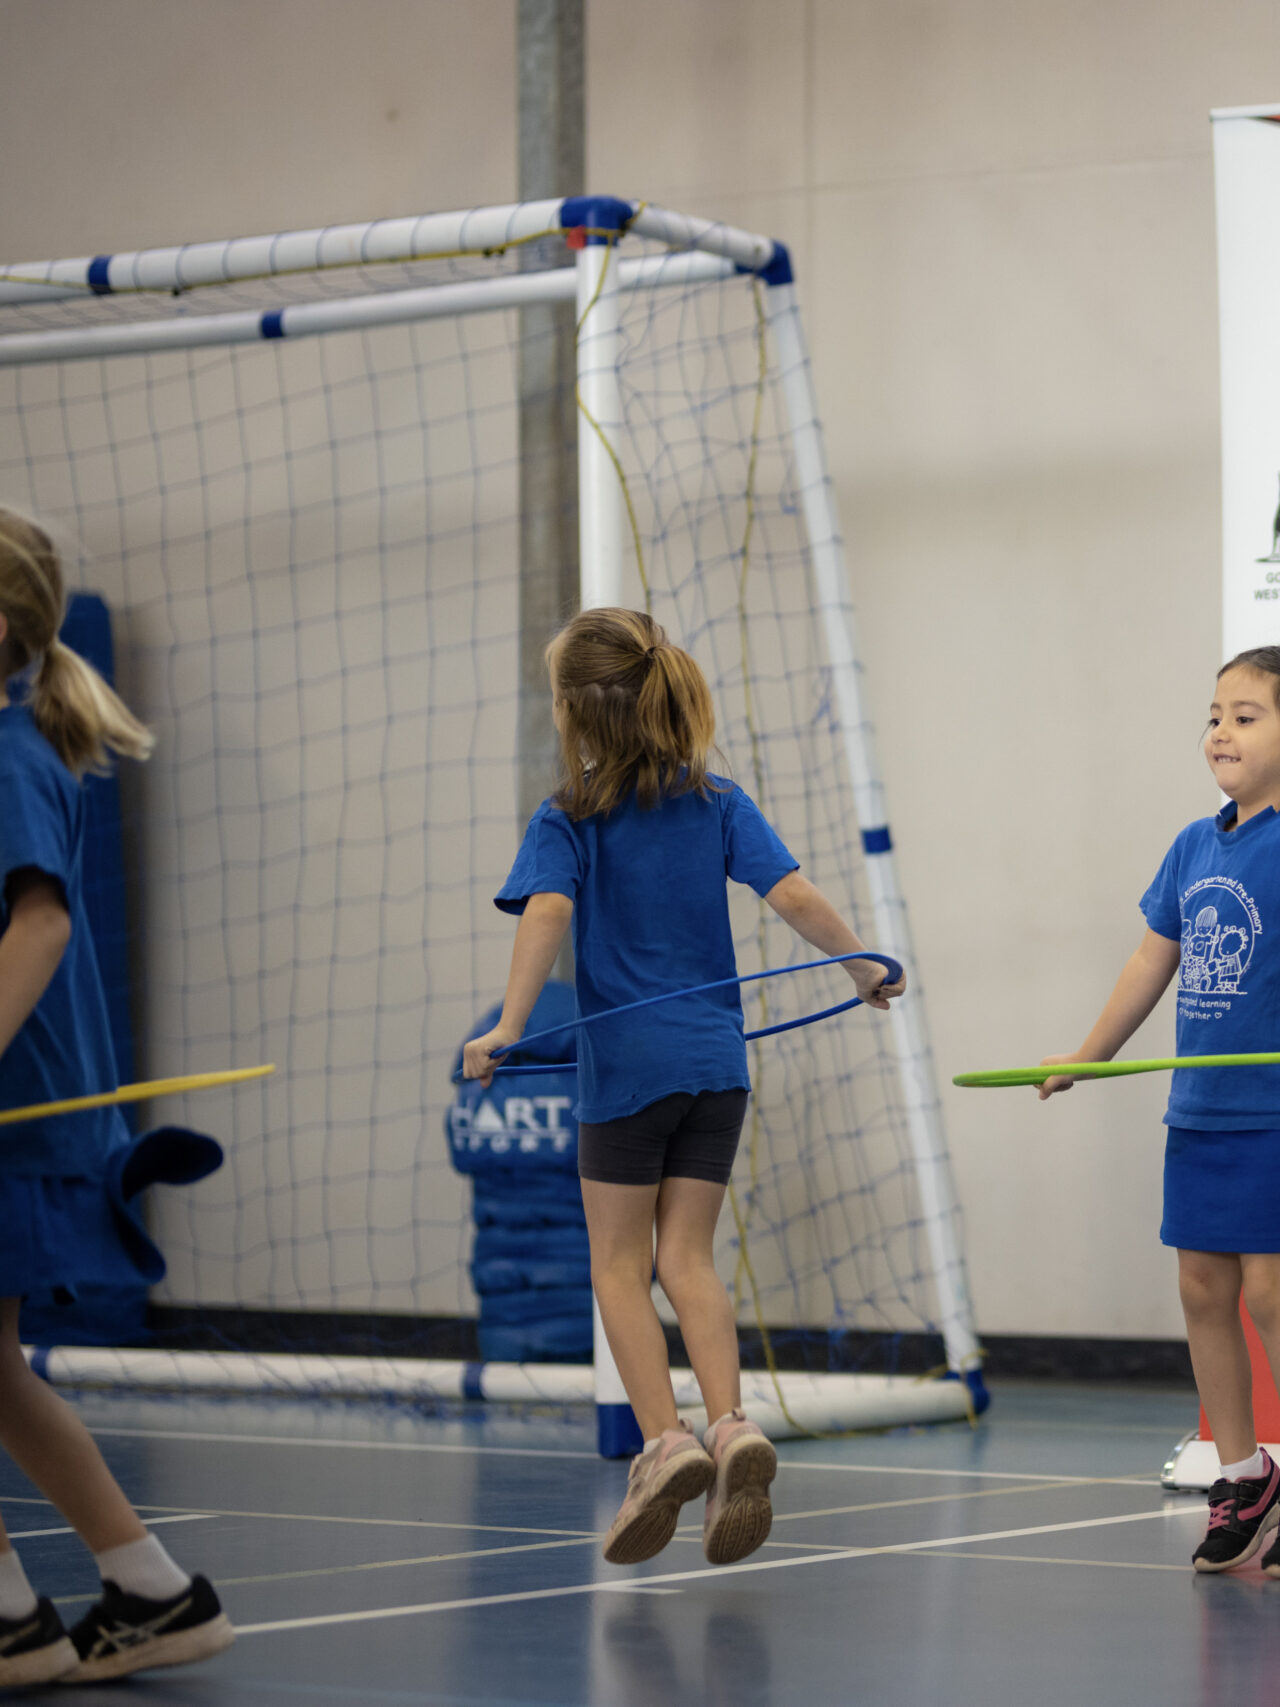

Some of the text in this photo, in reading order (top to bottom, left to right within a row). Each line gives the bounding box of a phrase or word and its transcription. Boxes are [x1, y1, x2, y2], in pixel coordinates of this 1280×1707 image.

[1236, 883, 1263, 935] Pre-Primary
[1183, 1009, 1211, 1020] together
[1199, 998, 1231, 1010] learning
[451, 1096, 571, 1132] HART
